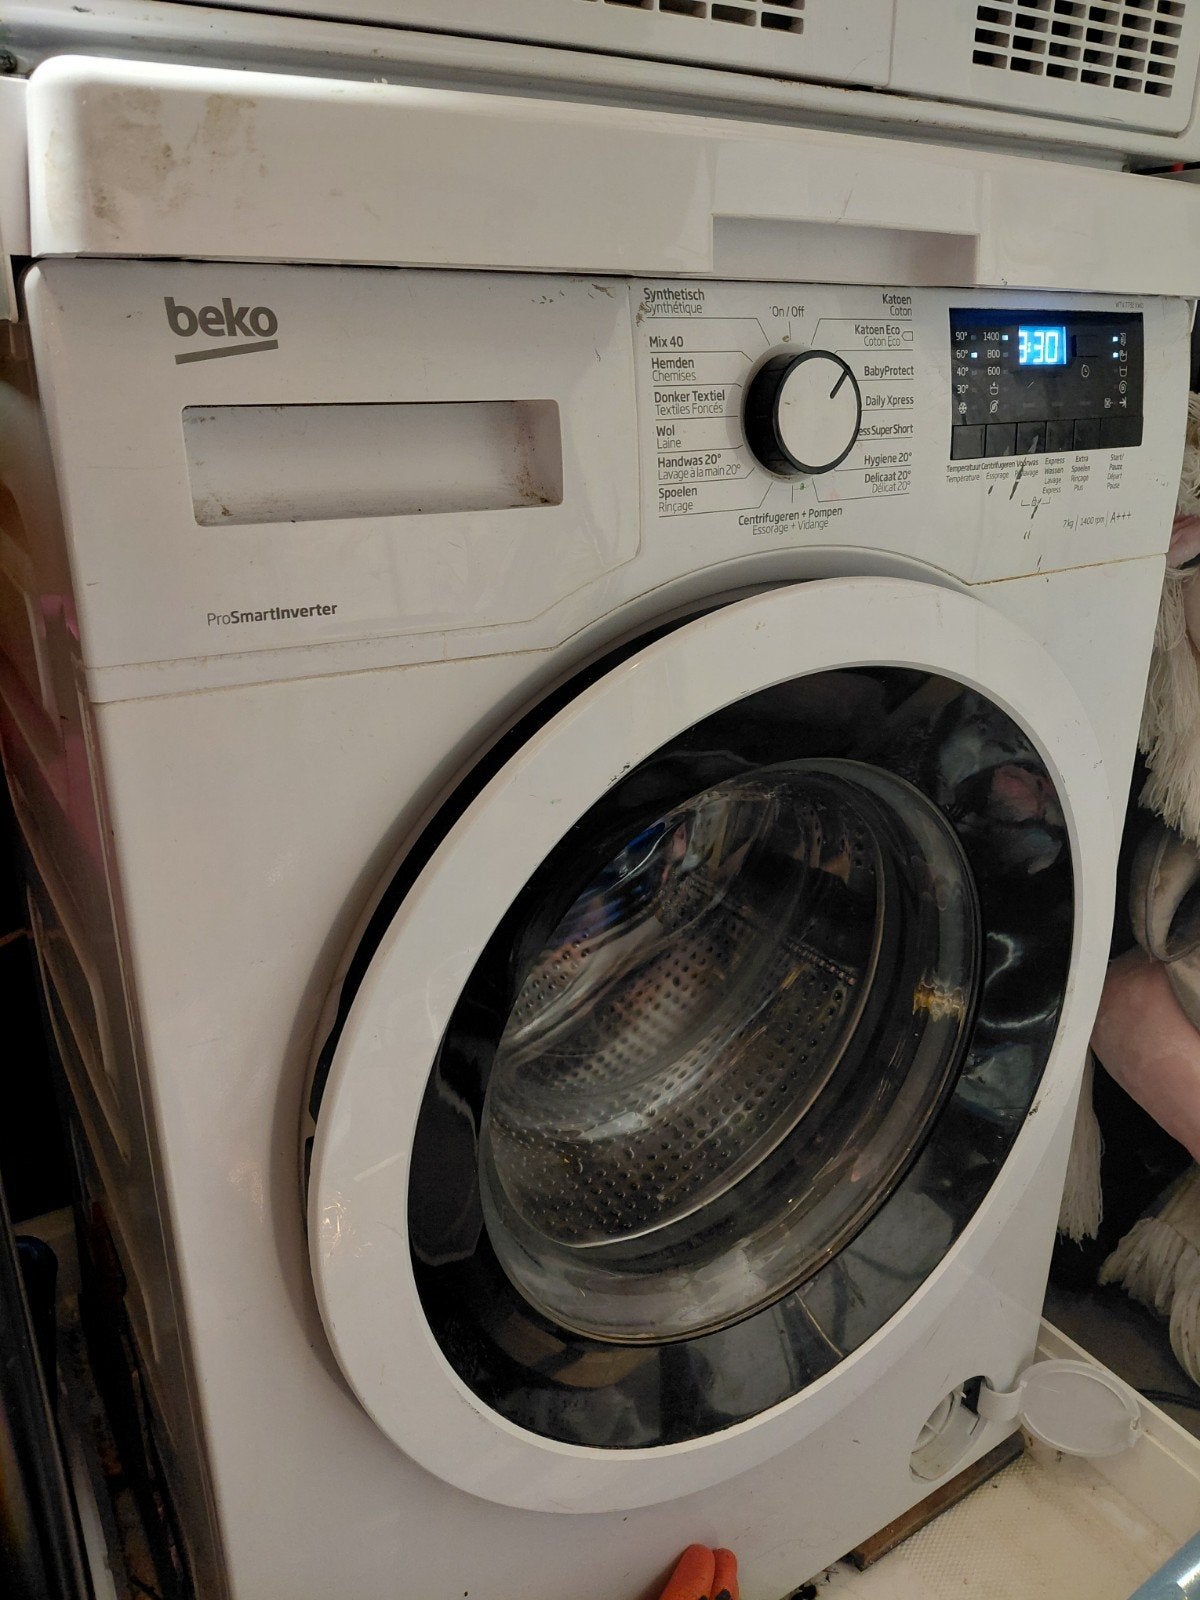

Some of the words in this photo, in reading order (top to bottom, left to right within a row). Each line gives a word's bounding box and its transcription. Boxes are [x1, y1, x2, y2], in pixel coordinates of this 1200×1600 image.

[643, 287, 705, 302] Synthetisch
[882, 293, 912, 305] Katoen
[644, 301, 703, 316] Synthétique
[772, 305, 785, 317] On
[791, 305, 805, 317] Off
[890, 305, 913, 316] Coton
[164, 297, 278, 337] beko
[854, 324, 885, 335] Katoen
[886, 324, 901, 335] Eco
[983, 331, 1000, 341] 1400
[649, 335, 668, 348] Mix
[669, 335, 684, 348] 40
[863, 336, 886, 347] Coton
[887, 336, 901, 347] Eco
[987, 349, 1000, 358] 800
[651, 357, 695, 369] Hemden
[652, 370, 697, 382] Chemises
[864, 365, 915, 378] BabyProtect
[987, 367, 1001, 376] 600
[654, 391, 690, 403] Donker
[692, 389, 725, 402] Textiel
[865, 395, 885, 408] Daily
[887, 395, 914, 407] Xpress
[654, 403, 691, 415] Textiles
[692, 402, 724, 414] Foncés
[656, 424, 675, 437] Wol
[657, 437, 682, 449] Laine
[658, 456, 703, 468] Handwas
[704, 454, 722, 465] 20°
[864, 454, 897, 467] Hygiene
[658, 469, 689, 481] Lavage
[690, 467, 695, 478] à
[696, 466, 704, 477] la
[705, 465, 725, 477] main
[864, 471, 896, 483] Delicaat
[658, 486, 698, 500] Spoelen
[872, 482, 896, 493] Délicat
[659, 501, 694, 514] Rinçage
[738, 511, 800, 526] Centrifugeren
[808, 507, 843, 520] Pompen
[752, 524, 789, 536] Essorage
[798, 518, 829, 531] Vidange
[207, 604, 338, 626] ProSmartInverter
